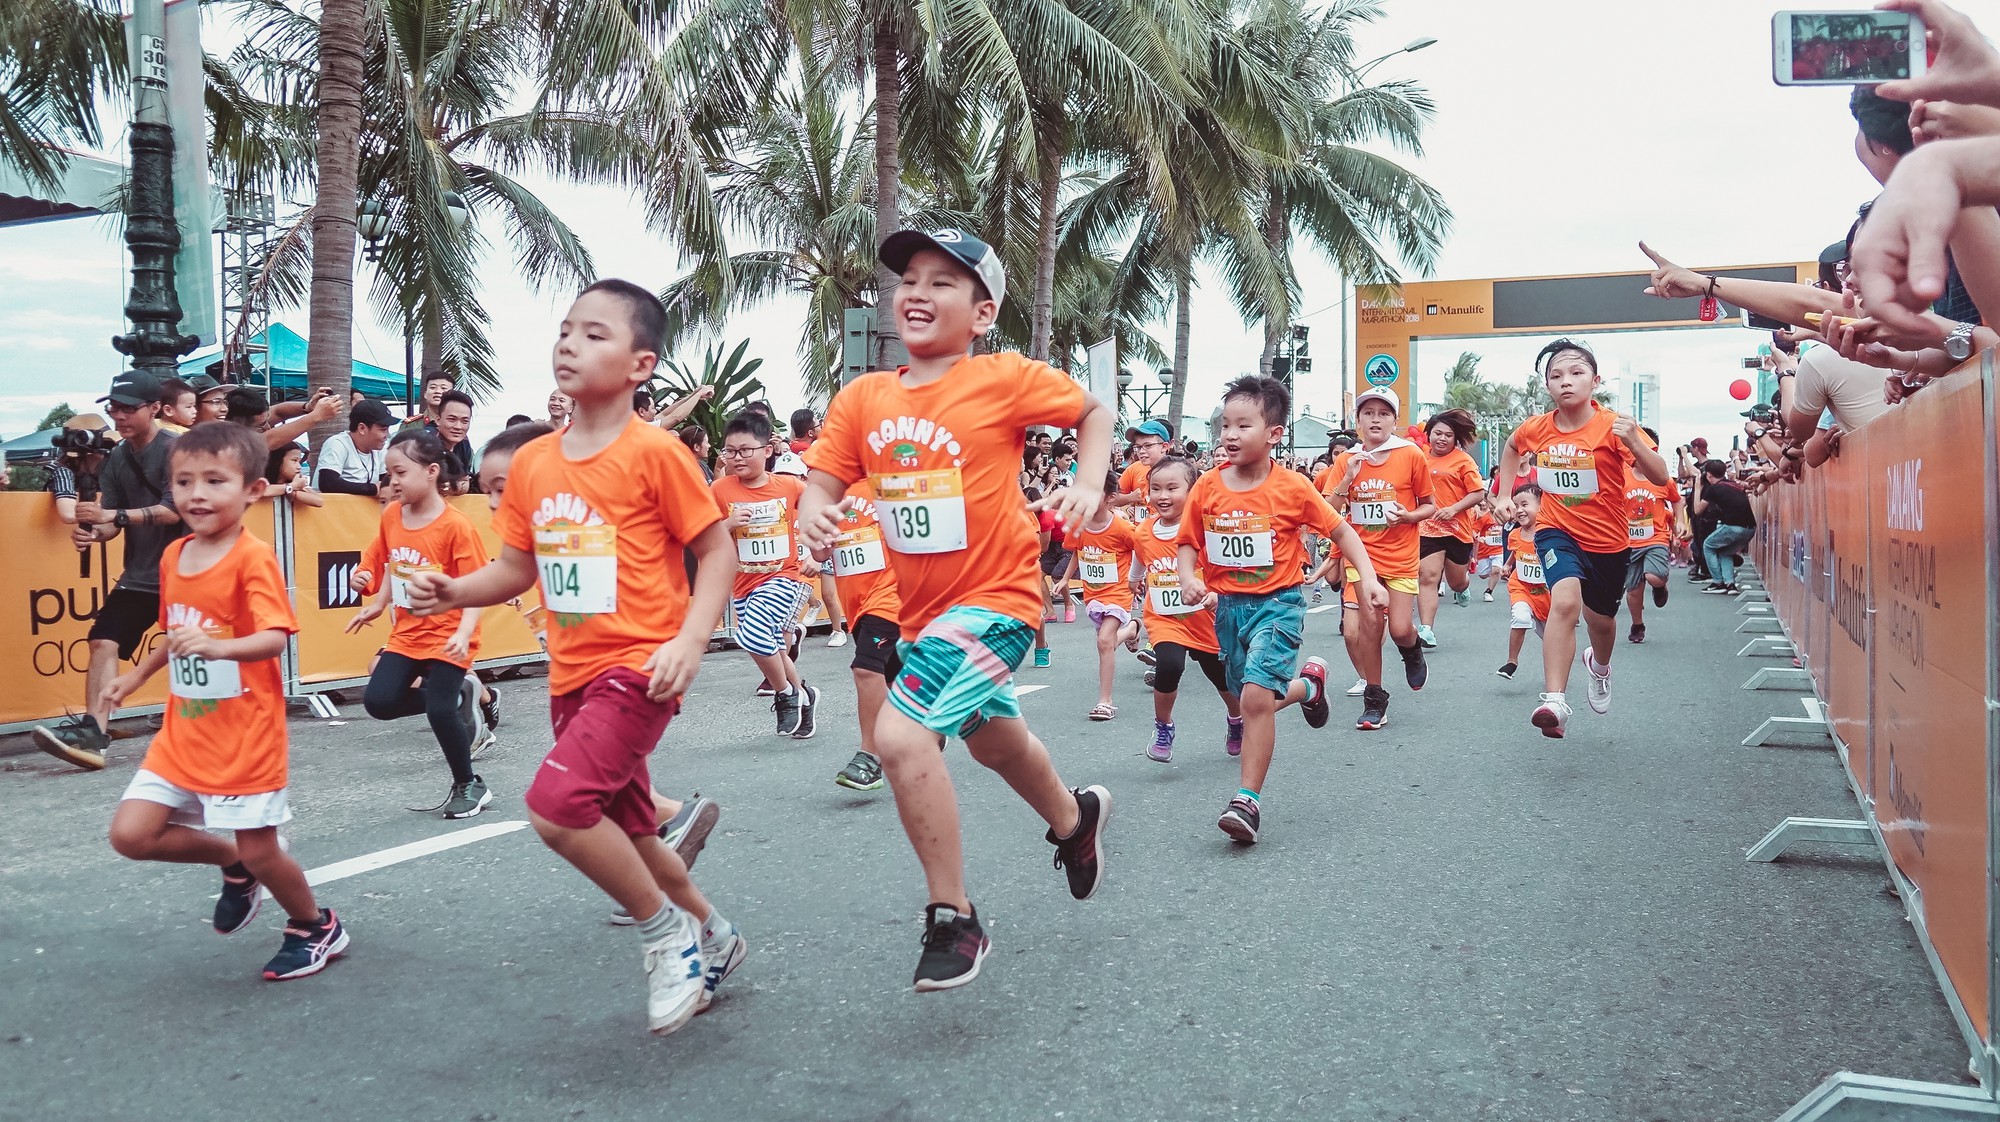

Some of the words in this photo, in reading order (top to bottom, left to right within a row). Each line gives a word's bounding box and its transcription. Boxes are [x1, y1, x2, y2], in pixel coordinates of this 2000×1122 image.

[144, 50, 167, 66] 30
[1440, 305, 1484, 315] Manulife
[1542, 443, 1587, 457] ONN
[1554, 471, 1580, 488] 103
[1361, 503, 1384, 519] 173
[891, 506, 931, 539] 139
[751, 539, 775, 556] 011
[1220, 535, 1255, 558] 206
[840, 547, 865, 568] 016
[543, 562, 580, 597] 104
[1086, 564, 1105, 578] 099
[1523, 564, 1541, 578] 076
[1161, 590, 1182, 607] 02
[172, 656, 209, 687] 186
